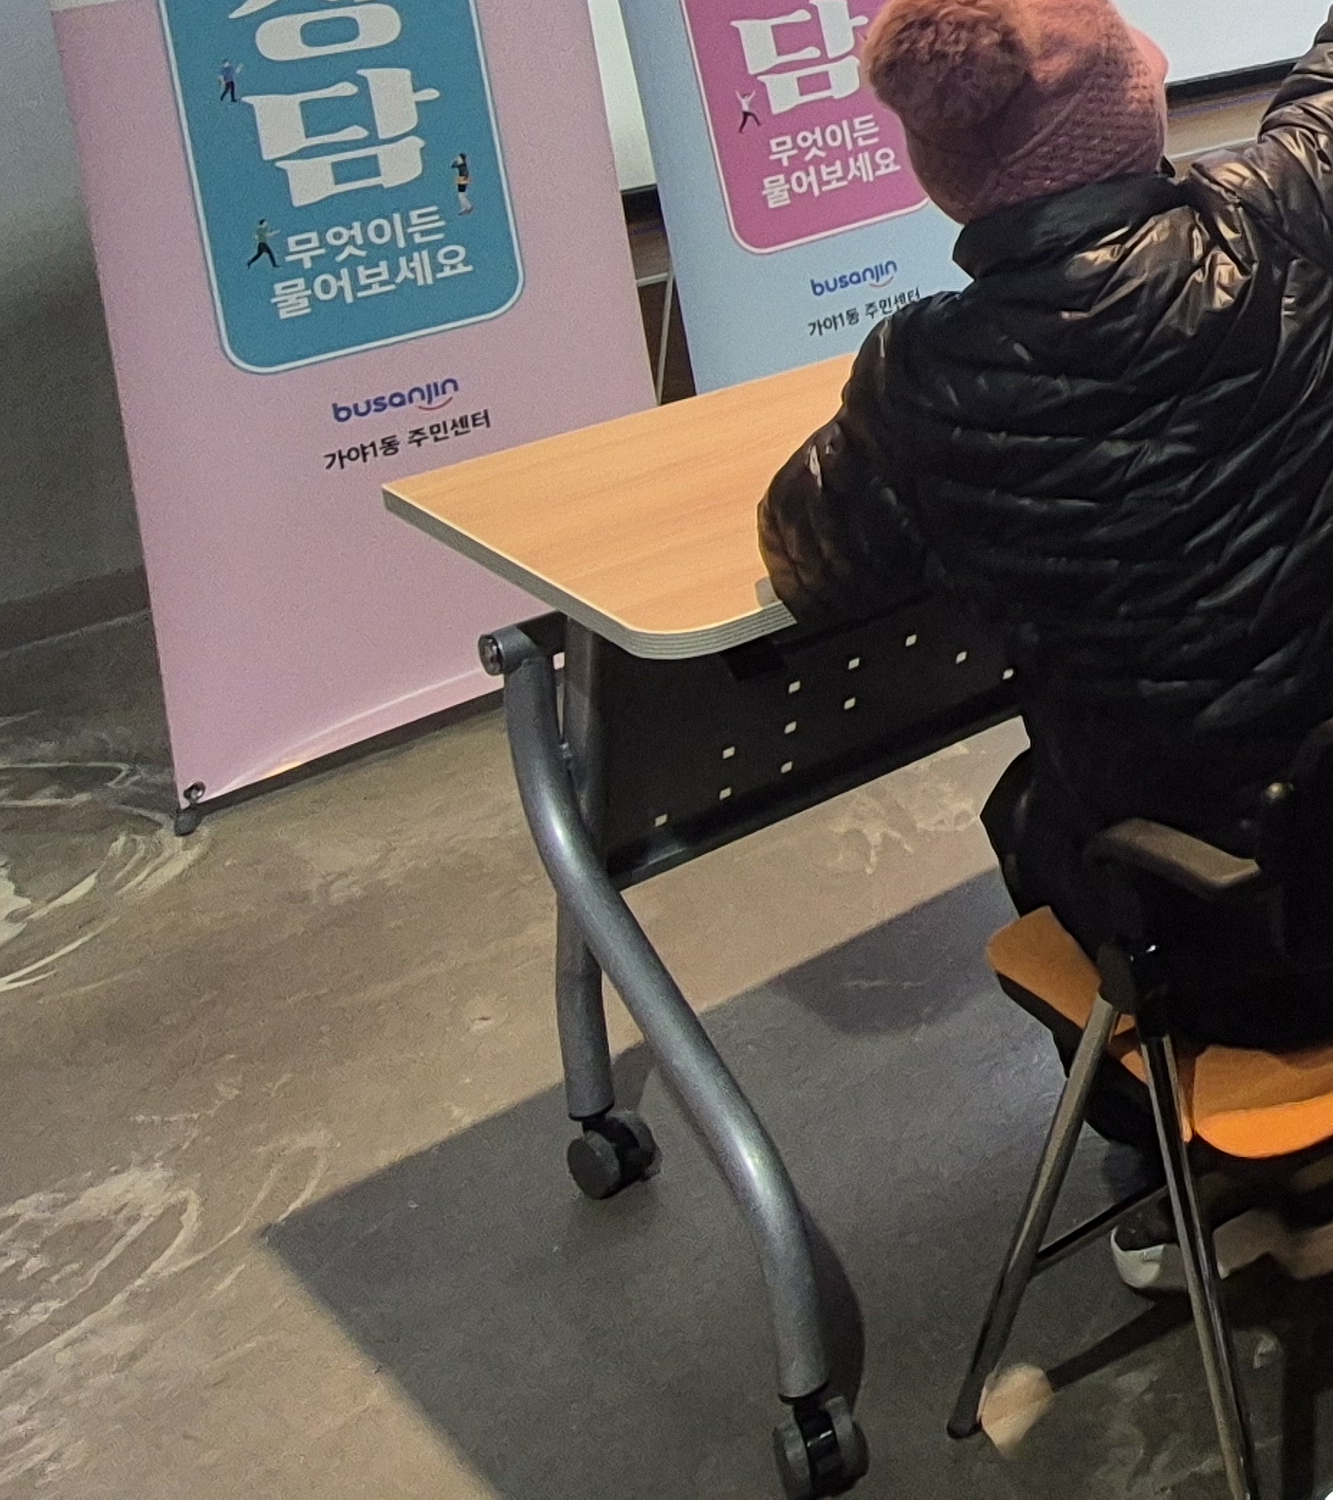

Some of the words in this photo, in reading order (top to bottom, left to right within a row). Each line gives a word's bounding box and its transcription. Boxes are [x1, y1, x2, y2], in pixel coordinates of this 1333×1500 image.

[769, 114, 880, 167] 무엇이든
[762, 147, 902, 209] 물어보세요
[285, 205, 446, 269] 무엇이든
[270, 244, 474, 320] 물어보세요
[810, 260, 898, 297] busanjin
[808, 306, 860, 337] 가야1동
[865, 286, 921, 320] 주민센터
[332, 378, 459, 423] busanjin
[324, 434, 401, 470] 가야1동
[407, 409, 491, 448] 주민센터
